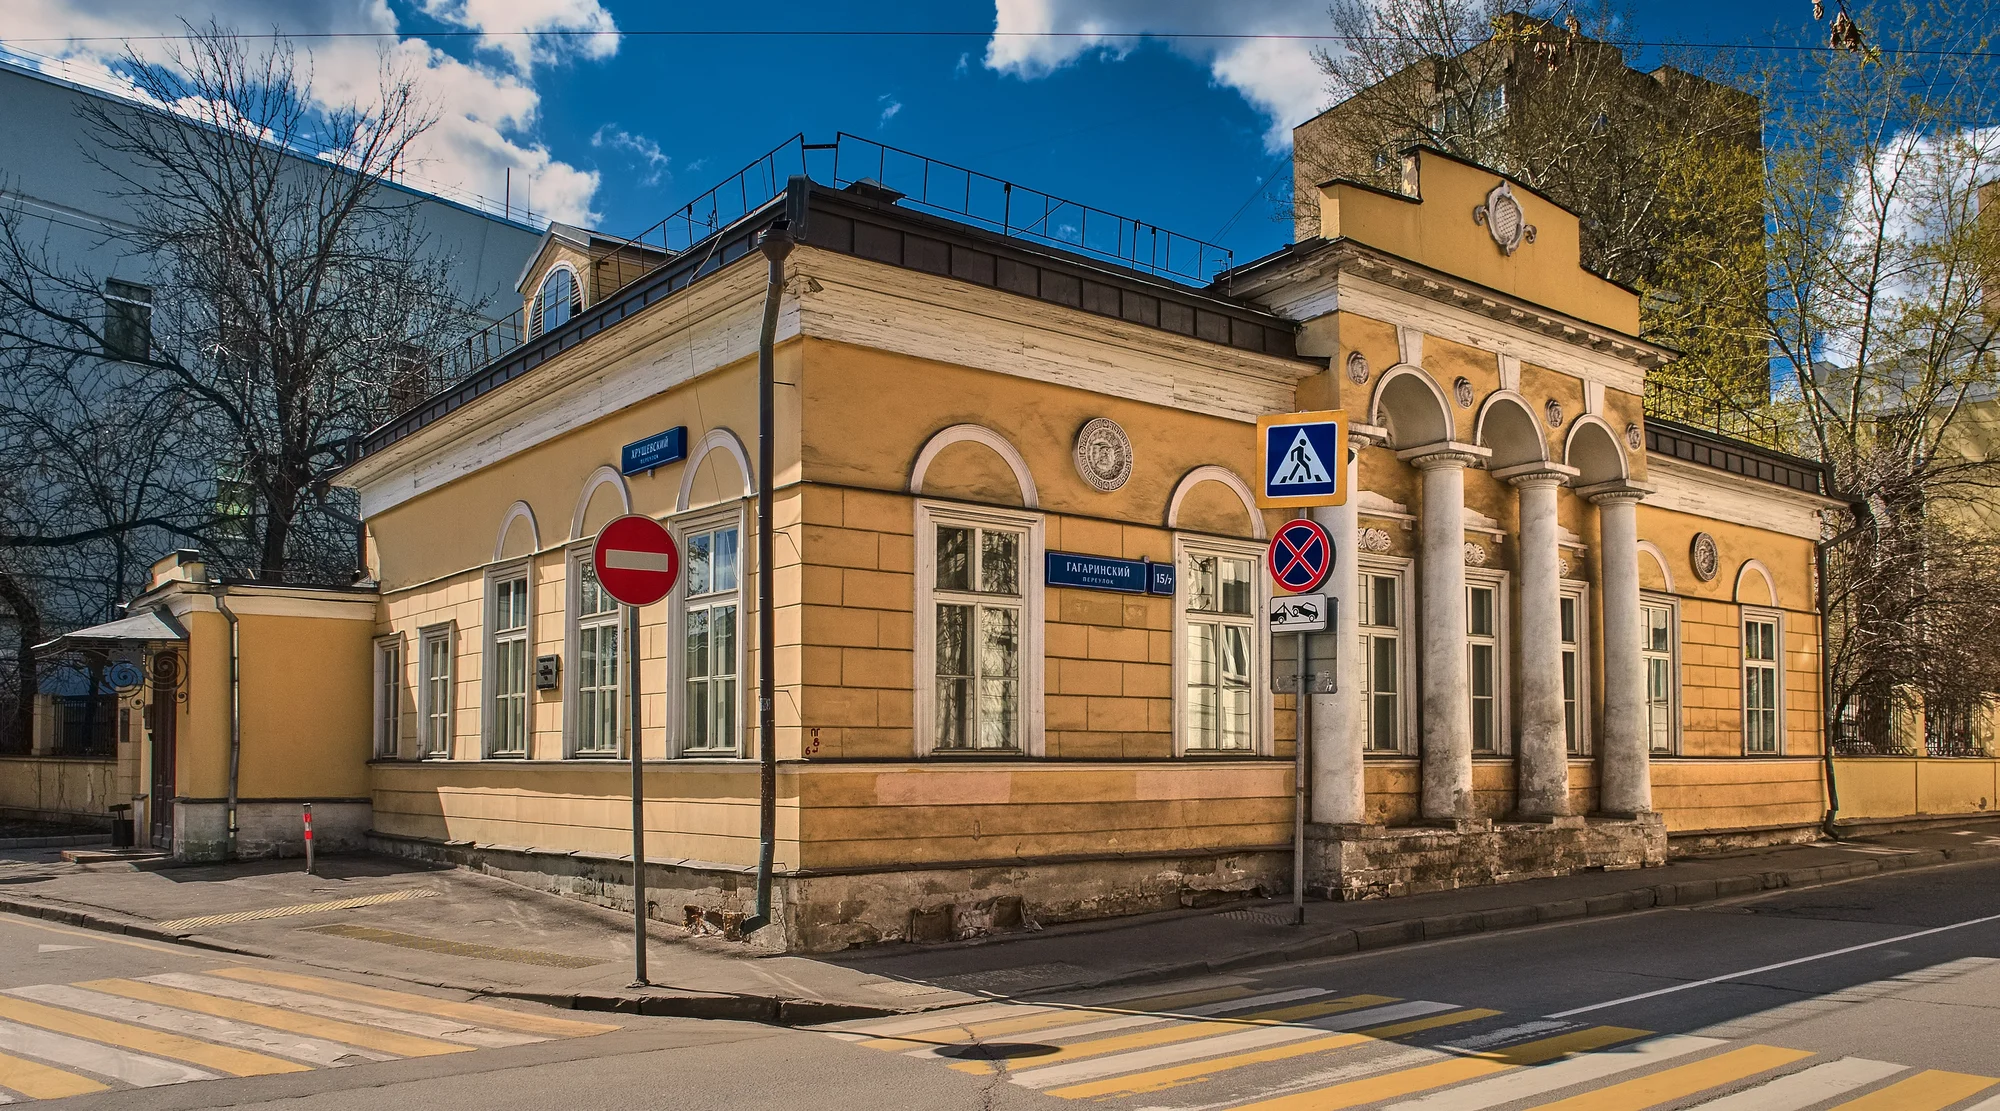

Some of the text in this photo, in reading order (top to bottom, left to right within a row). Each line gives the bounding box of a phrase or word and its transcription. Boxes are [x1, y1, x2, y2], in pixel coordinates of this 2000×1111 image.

[1066, 562, 1130, 577] ГАГАРИНСКИЙ
[1082, 576, 1114, 585] ПЕРЕУЛОК
[1156, 573, 1173, 585] 15/7
